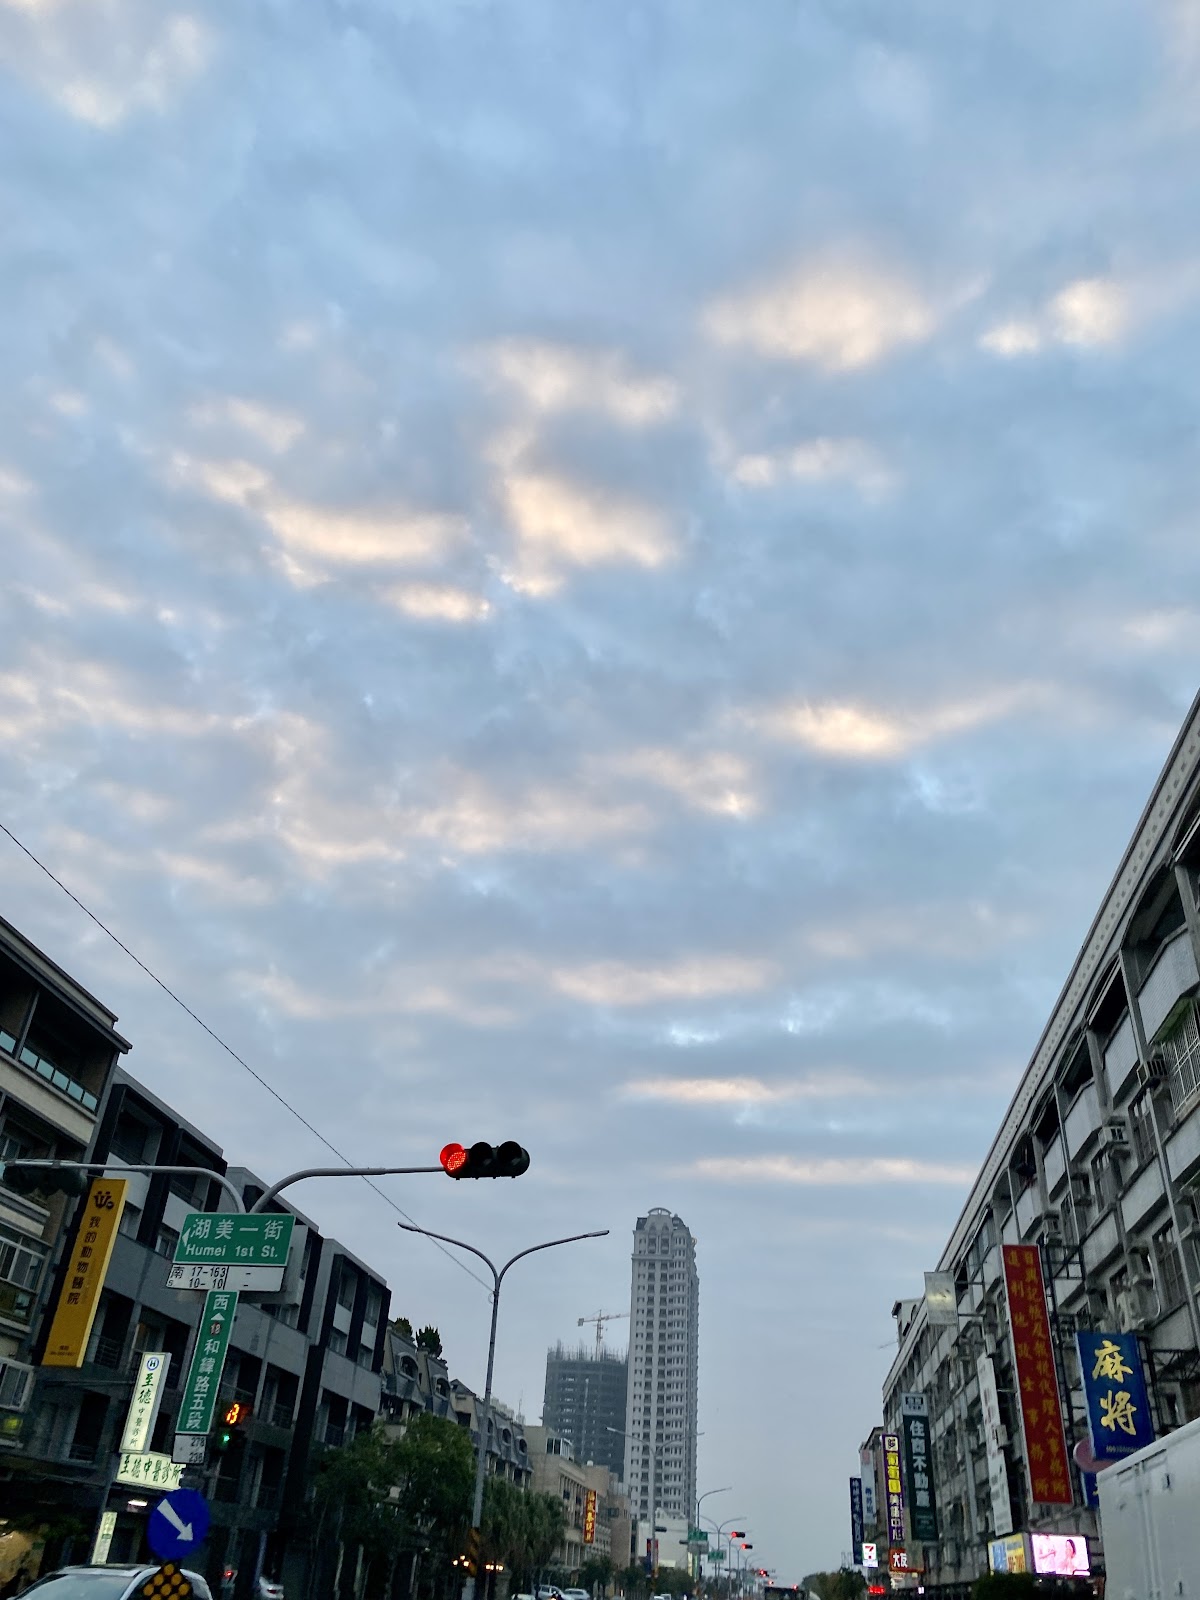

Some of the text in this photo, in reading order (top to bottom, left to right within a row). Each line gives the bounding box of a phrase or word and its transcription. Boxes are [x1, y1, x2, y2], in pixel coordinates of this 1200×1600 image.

[190, 1218, 283, 1241] 湖美一街
[66, 1215, 101, 1305] 我的動物醫院
[185, 1243, 279, 1258] Humei 1st St.
[169, 1266, 226, 1279] 南 17-163
[213, 1294, 230, 1310] 西
[186, 1338, 221, 1430] 和緯路五段
[1092, 1339, 1137, 1436] 麻將
[120, 1454, 182, 1484] 至德中醫診所
